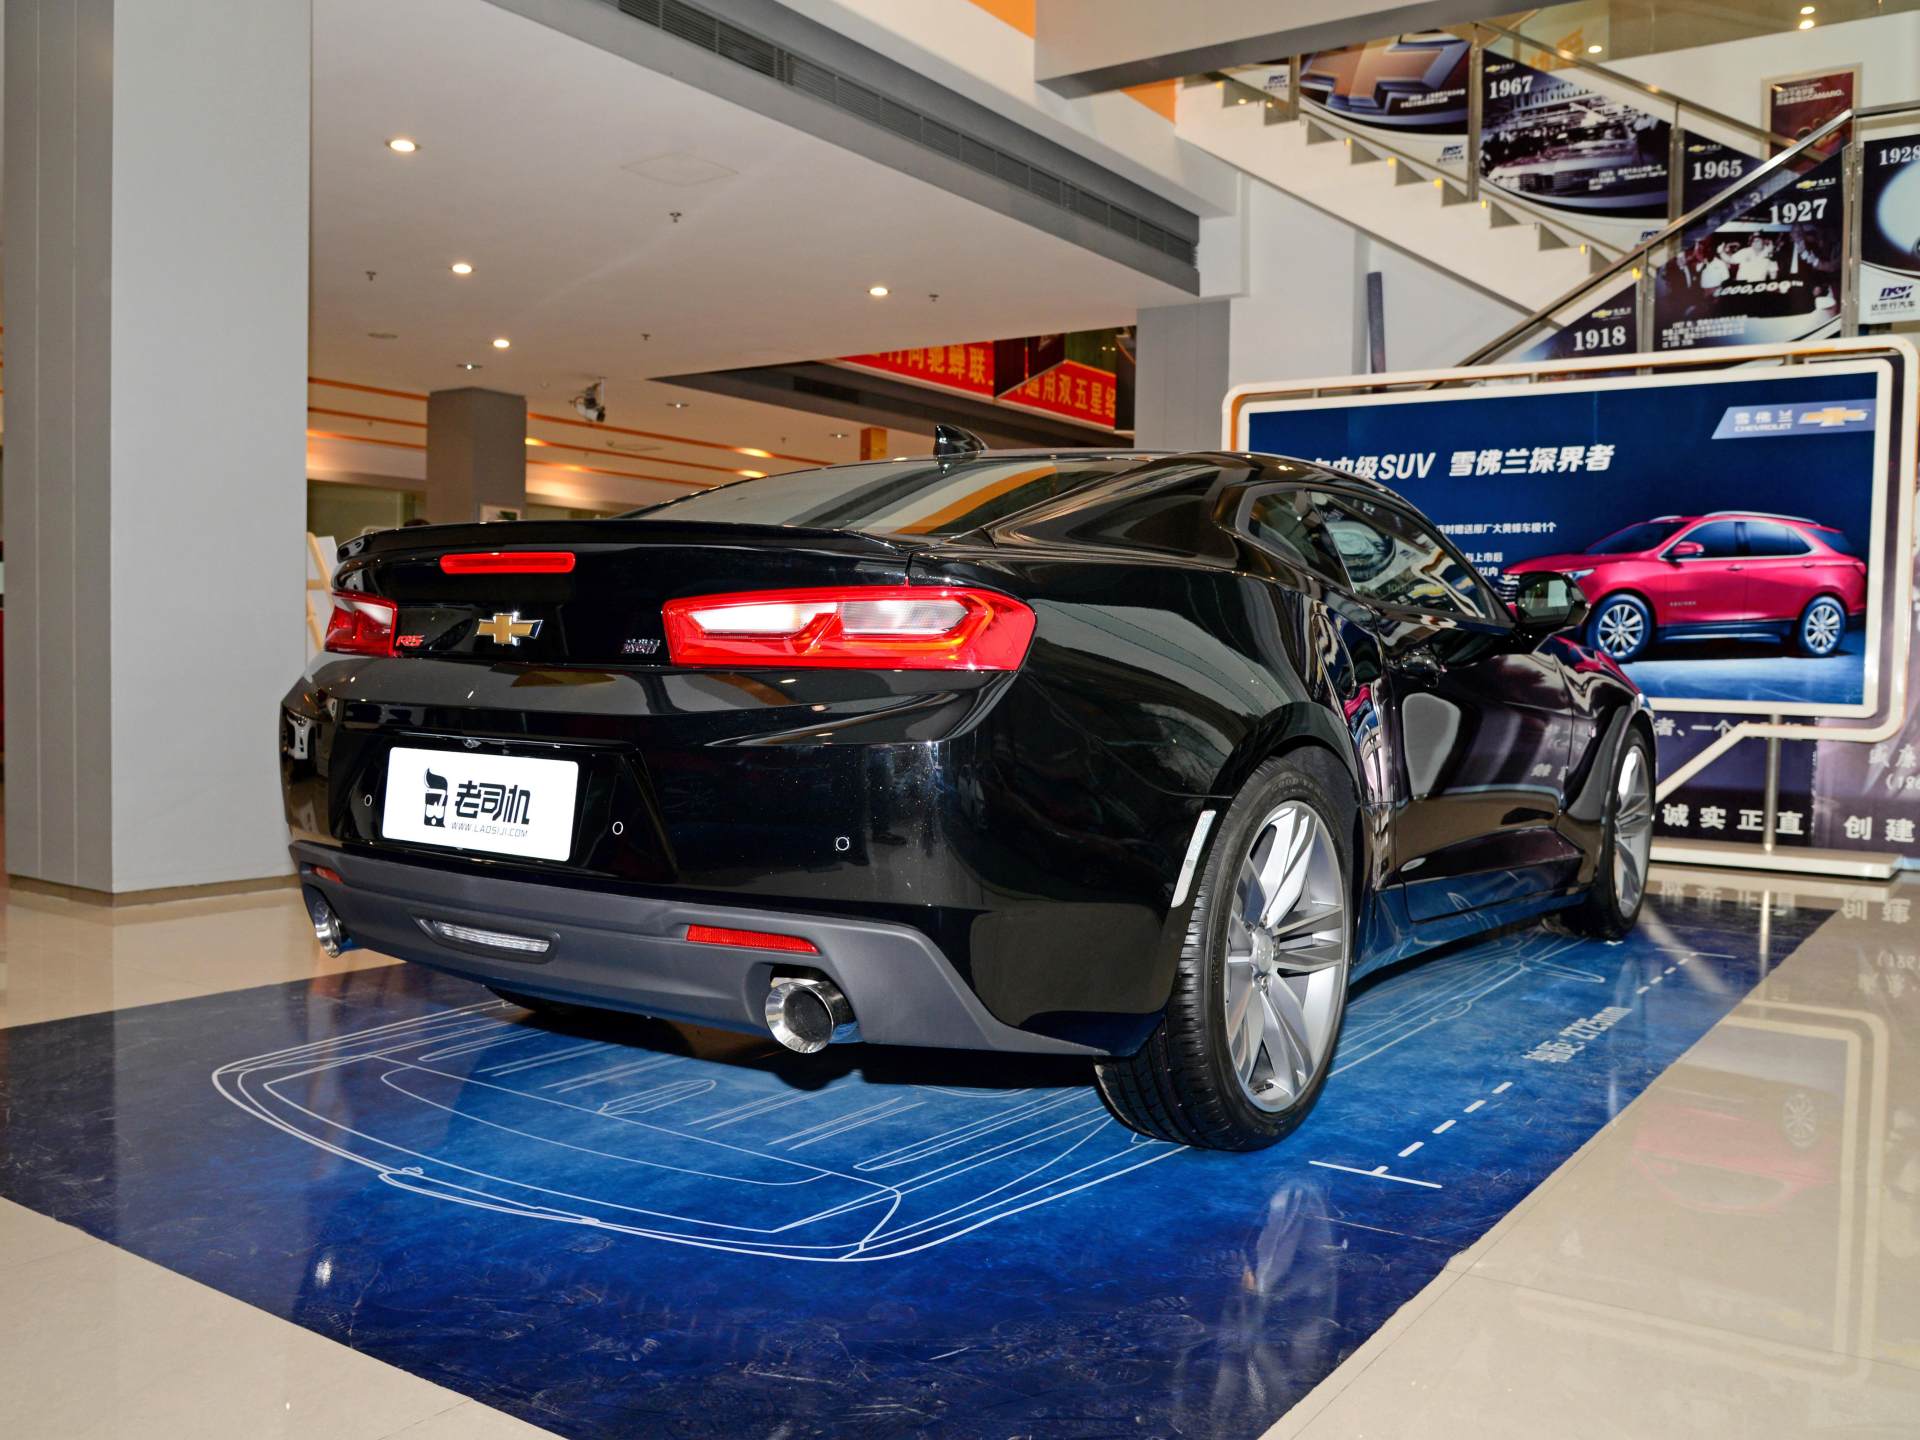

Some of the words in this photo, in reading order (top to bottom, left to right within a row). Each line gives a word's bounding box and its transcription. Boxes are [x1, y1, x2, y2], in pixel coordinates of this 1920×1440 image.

[1489, 75, 1534, 99] 1967
[1692, 159, 1743, 181] 1965
[1769, 198, 1828, 225] 1927
[1573, 326, 1627, 351] 1918
[1449, 443, 1616, 477] 雪佛兰探界者
[396, 635, 425, 647] RS
[455, 780, 531, 825] 老司机
[450, 821, 529, 838] WWW.LAOSIJI.COM
[1663, 803, 1805, 836] 诚实正直
[1844, 815, 1915, 843] 创建
